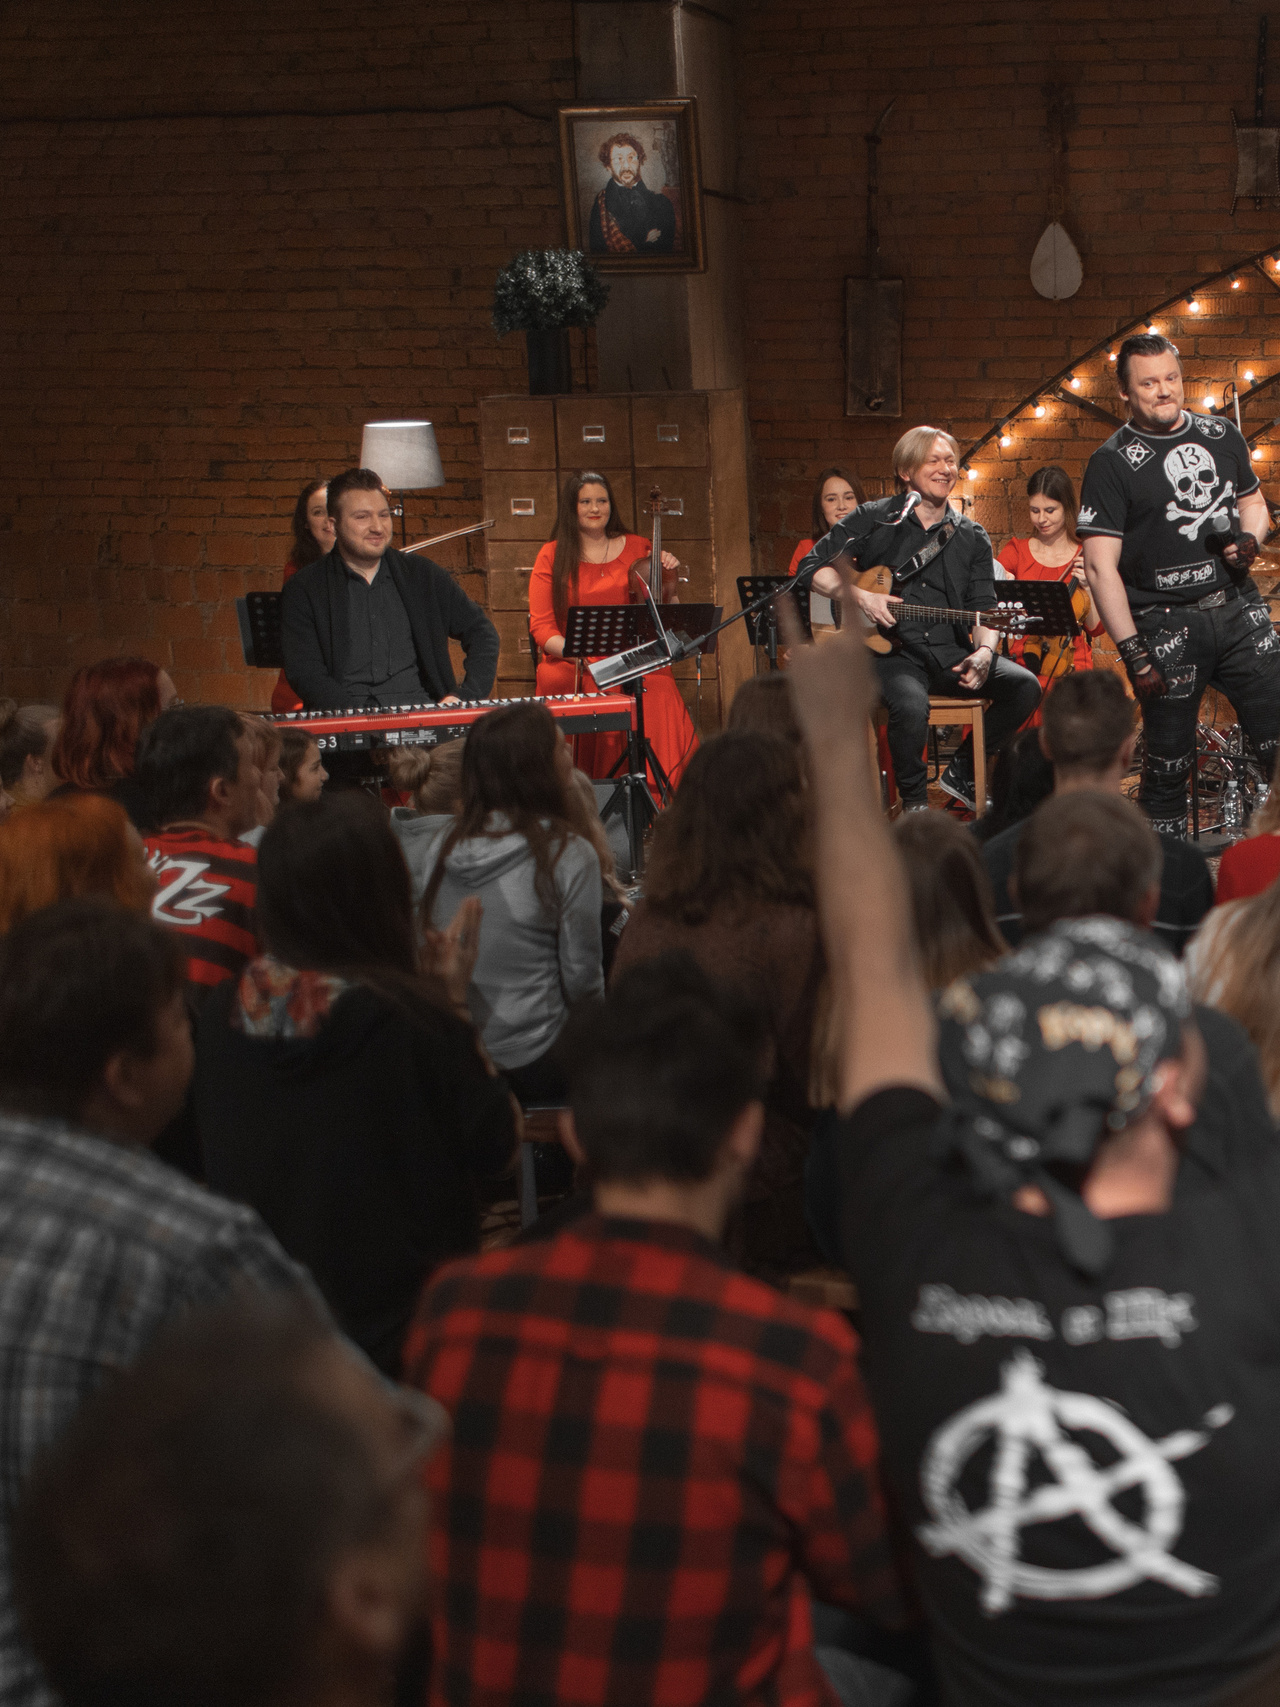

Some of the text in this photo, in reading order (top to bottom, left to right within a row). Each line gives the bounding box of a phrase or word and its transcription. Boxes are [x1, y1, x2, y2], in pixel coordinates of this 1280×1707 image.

[1176, 446, 1201, 469] 13
[1192, 564, 1213, 583] DEAD
[1155, 635, 1183, 658] ONE
